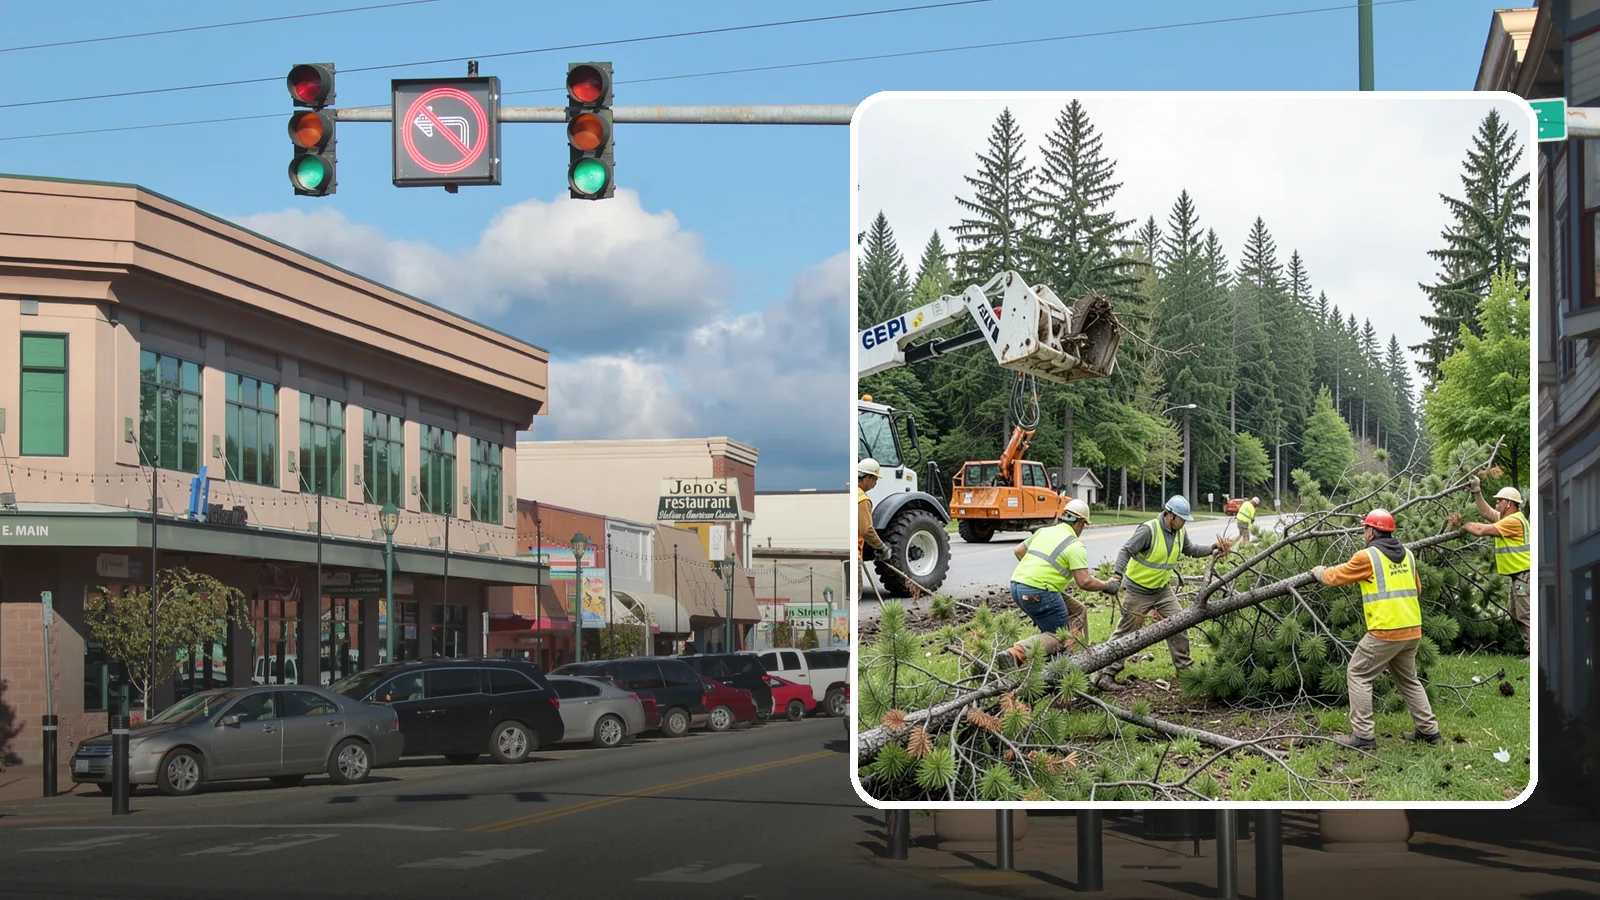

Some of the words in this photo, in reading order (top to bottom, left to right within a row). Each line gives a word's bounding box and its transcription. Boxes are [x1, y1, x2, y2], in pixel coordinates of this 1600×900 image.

[861, 315, 908, 350] GEPI
[669, 479, 727, 494] Jeno's
[664, 496, 731, 509] restaurant
[658, 509, 681, 520] Italian
[685, 509, 714, 519] American
[714, 509, 738, 519] Cuisine
[2, 525, 13, 536] E.
[15, 525, 49, 537] MAIN
[797, 607, 829, 617] Street
[790, 619, 824, 627] lass
